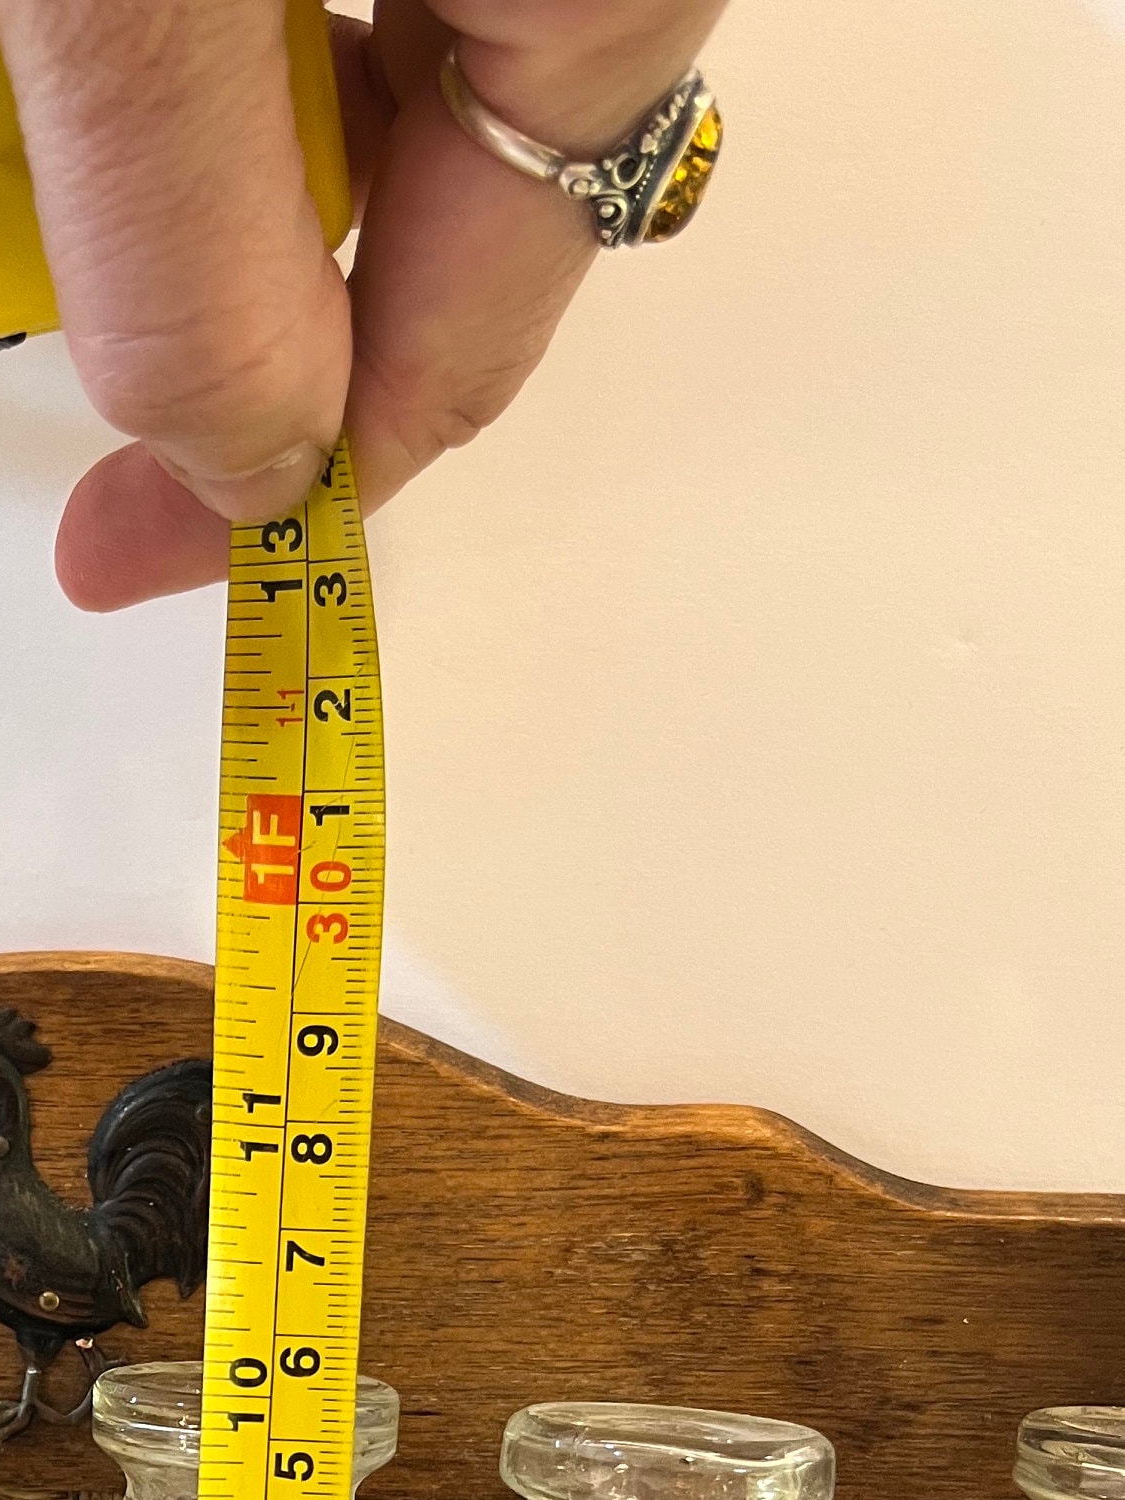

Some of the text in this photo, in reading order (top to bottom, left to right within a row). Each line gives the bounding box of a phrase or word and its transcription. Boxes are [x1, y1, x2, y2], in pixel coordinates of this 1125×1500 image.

[260, 516, 303, 603] 13
[313, 572, 347, 607] 3
[313, 688, 351, 722] 2
[309, 805, 350, 827] 1
[251, 811, 296, 884] 1F
[305, 859, 354, 945] 30
[296, 1024, 339, 1057] 9
[240, 1092, 282, 1162] 11
[290, 1133, 333, 1165] 8
[285, 1240, 325, 1272] 7
[279, 1347, 321, 1378] 6
[227, 1357, 268, 1432] 10
[274, 1452, 314, 1482] 5
